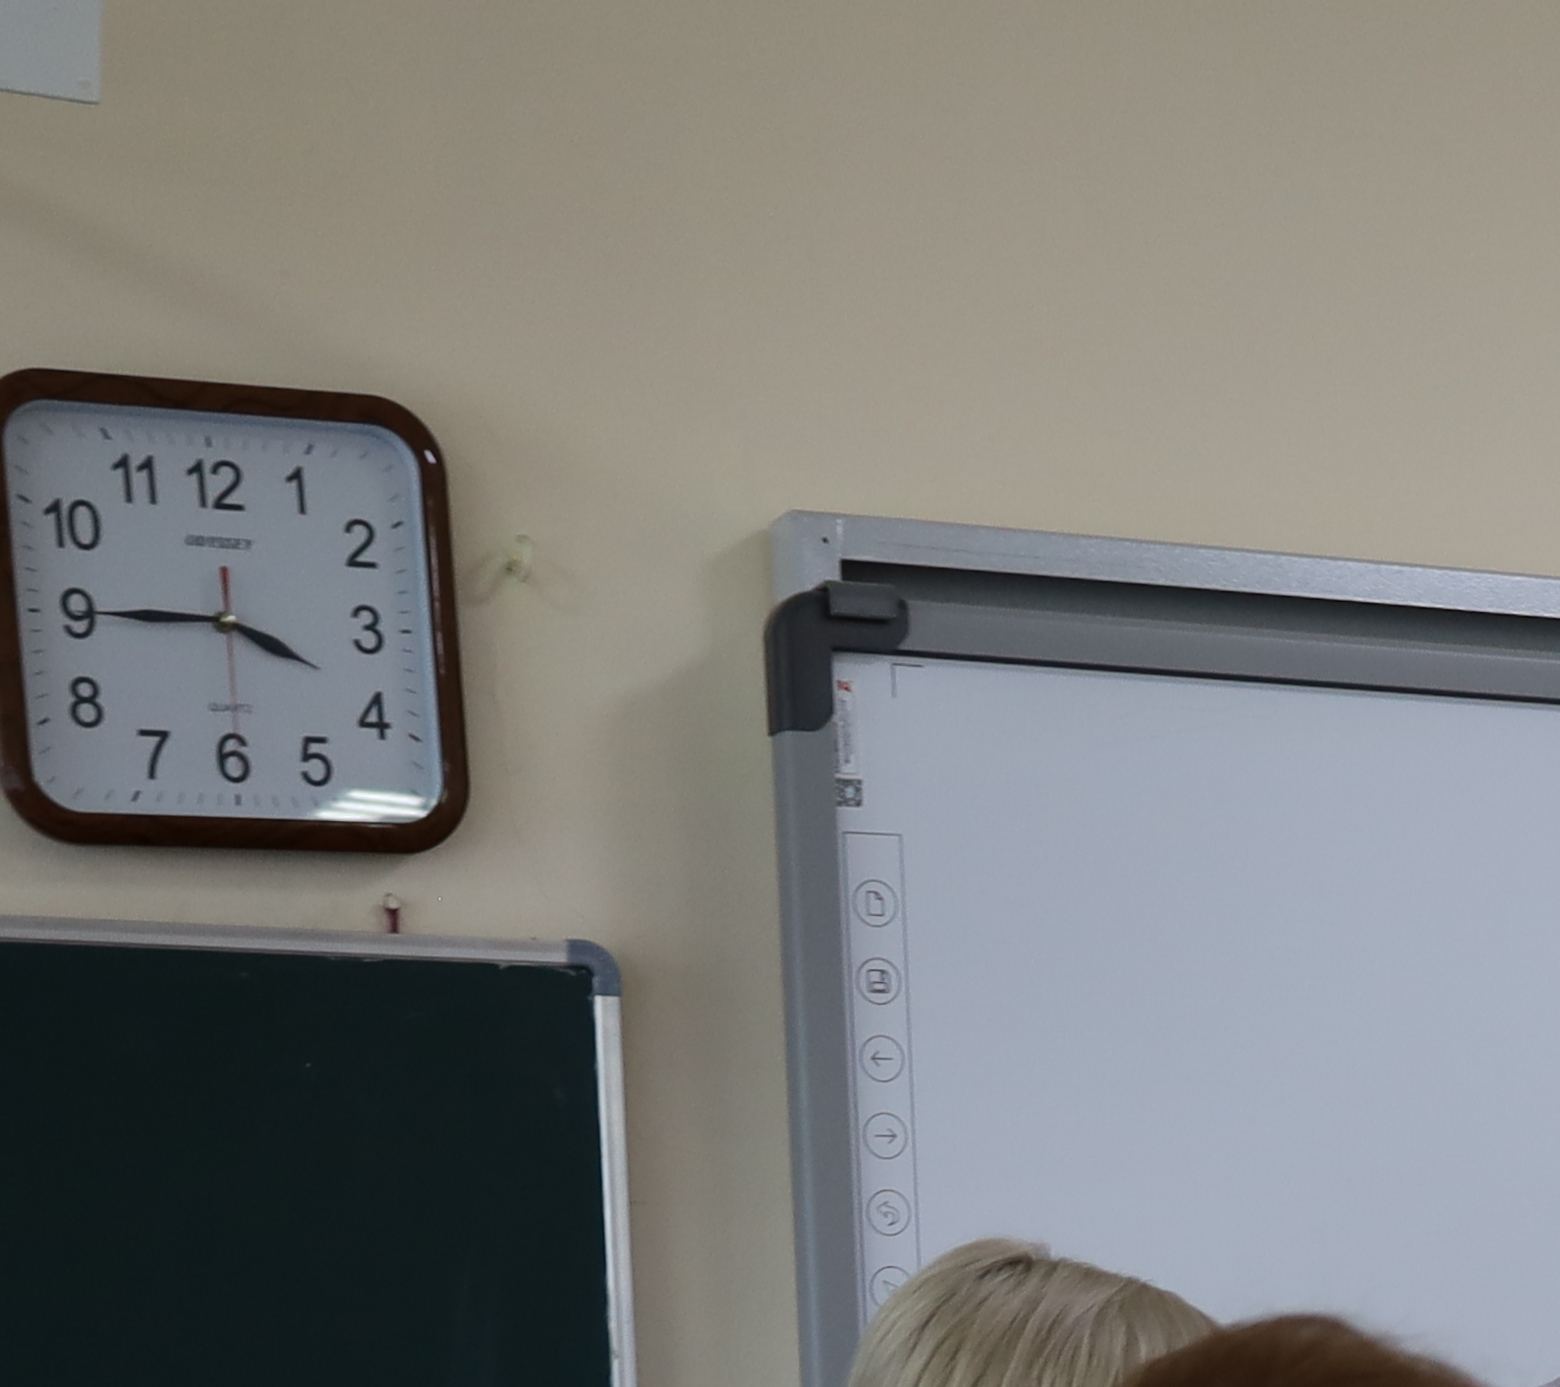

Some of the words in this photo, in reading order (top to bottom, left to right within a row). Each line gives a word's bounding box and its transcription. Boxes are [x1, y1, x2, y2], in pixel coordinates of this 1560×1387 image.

[111, 453, 158, 505] 11
[186, 458, 245, 511] 12
[285, 466, 307, 515] 1
[43, 499, 101, 551] 10
[343, 518, 378, 569] 2
[60, 587, 96, 640] 9
[351, 604, 384, 655] 3
[69, 676, 104, 728] 8
[358, 692, 391, 740] 4
[137, 729, 170, 780] 7
[216, 733, 250, 784] 6
[300, 736, 333, 786] 5
